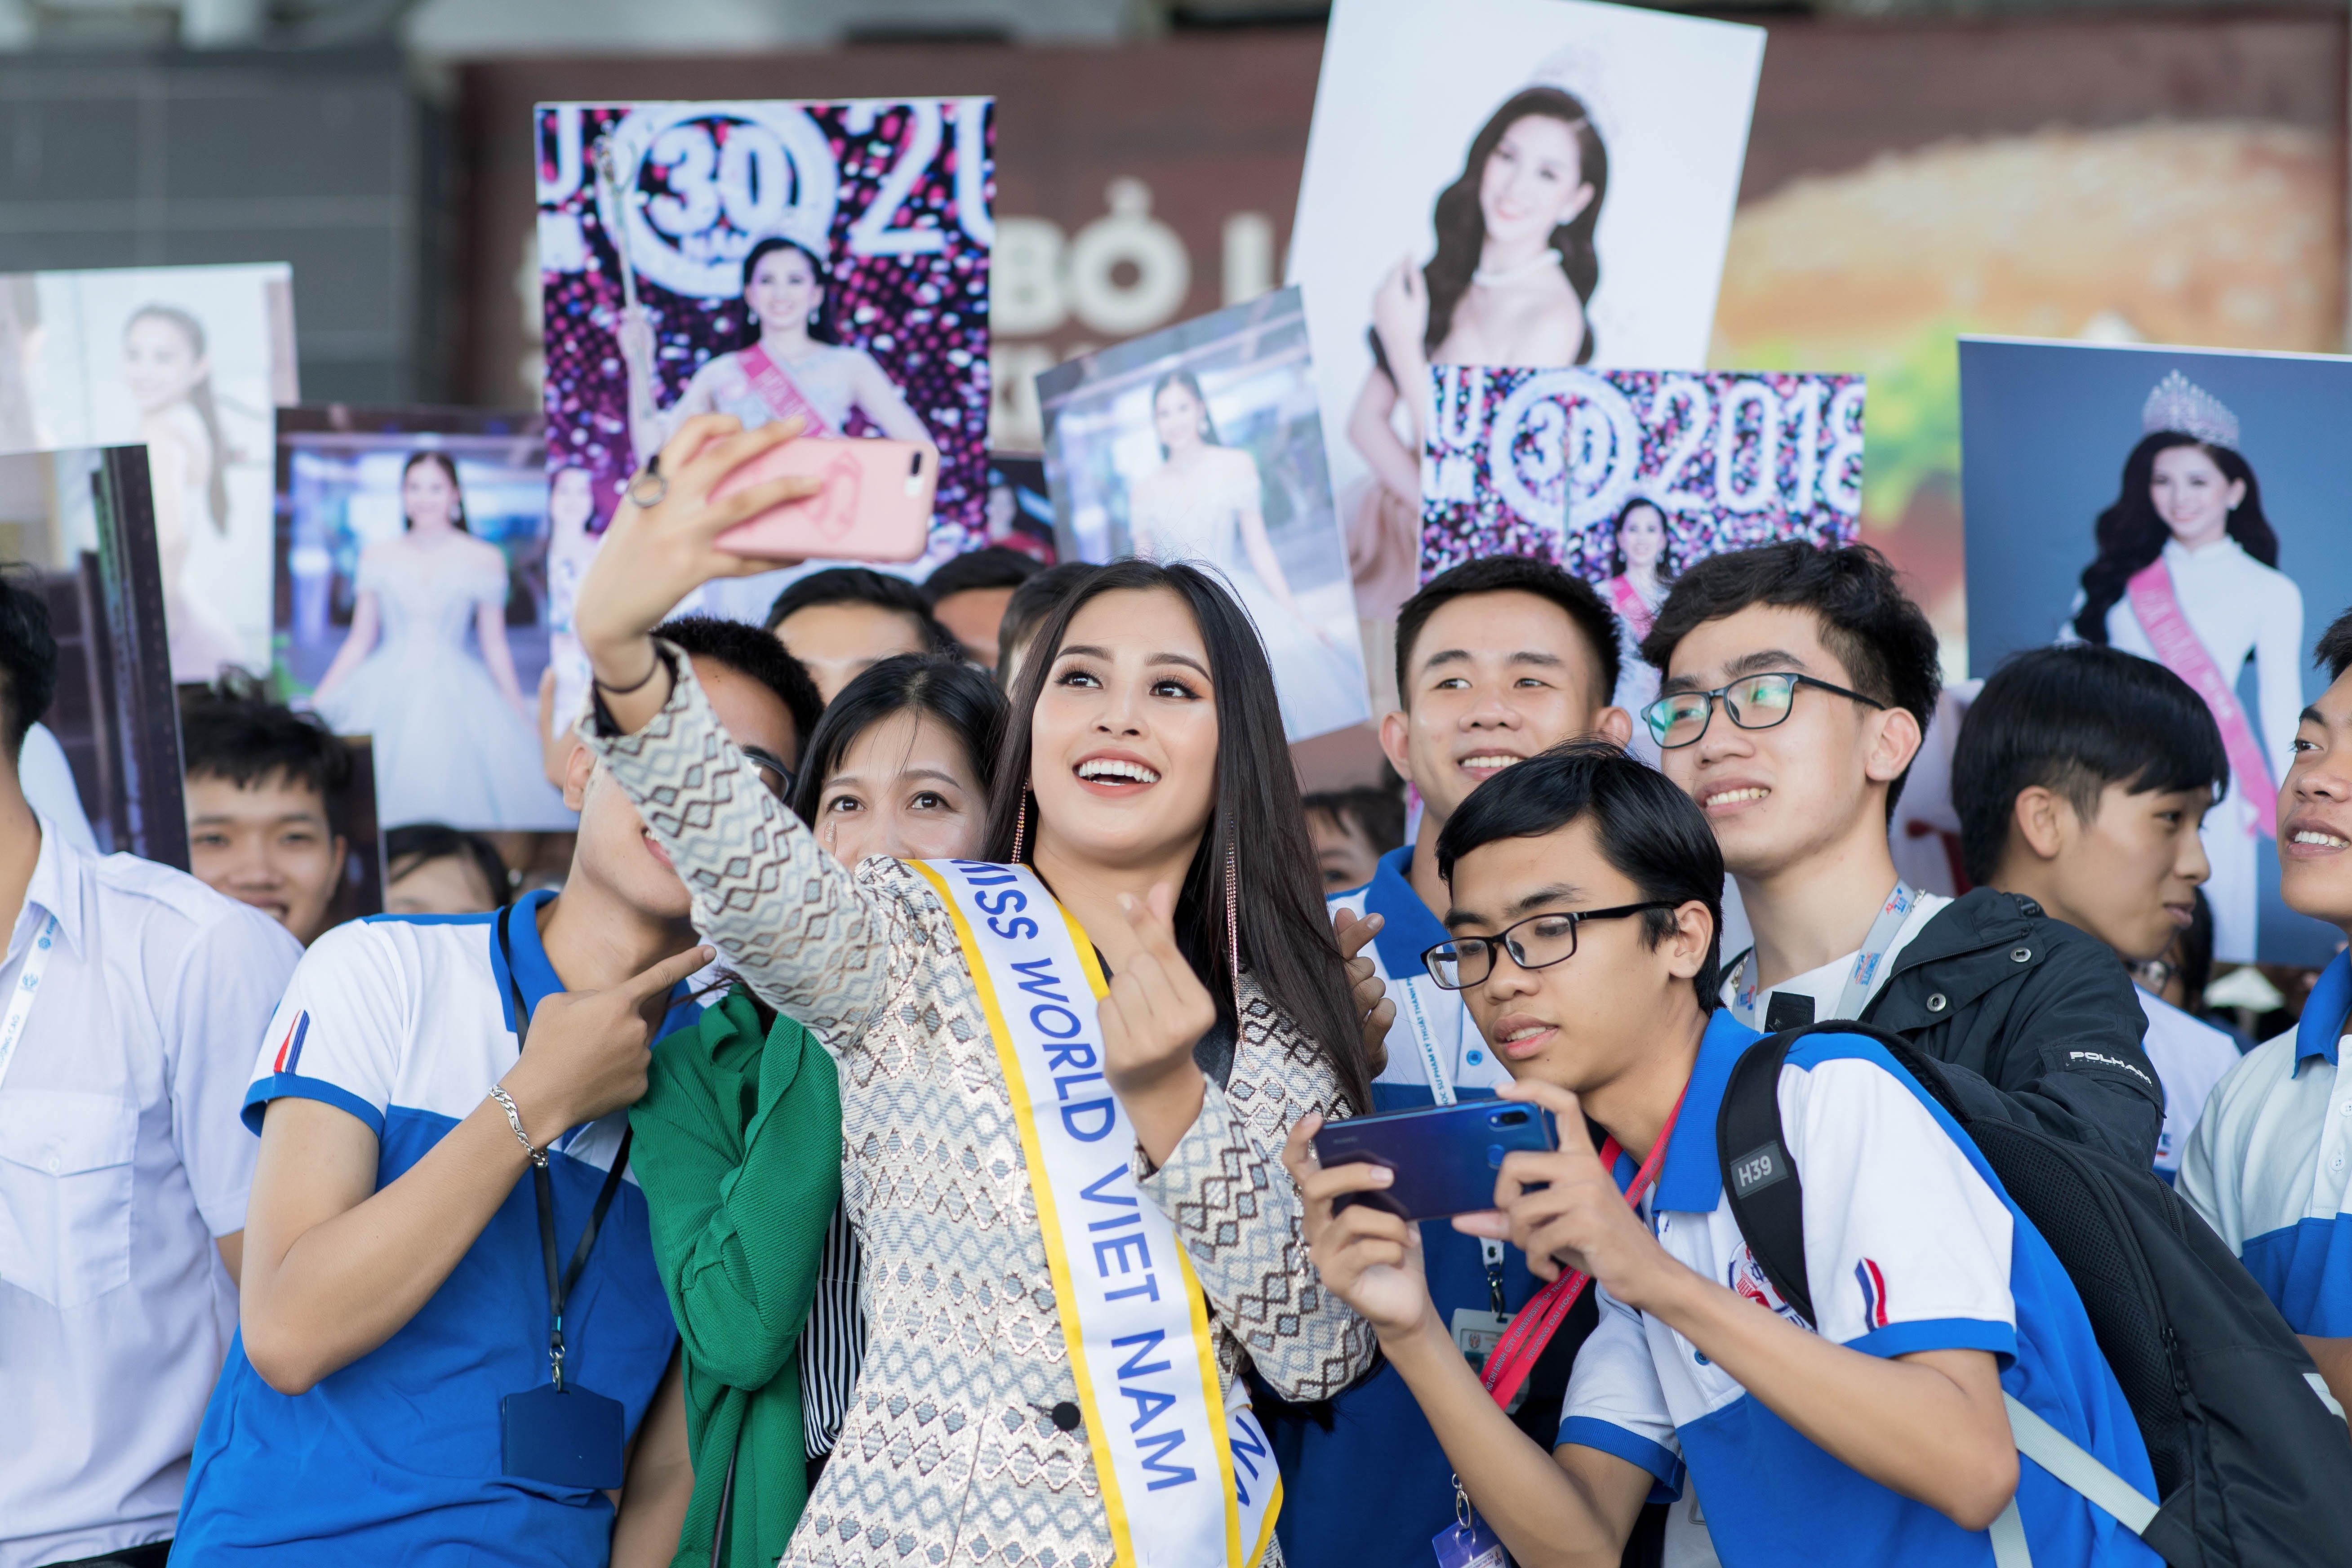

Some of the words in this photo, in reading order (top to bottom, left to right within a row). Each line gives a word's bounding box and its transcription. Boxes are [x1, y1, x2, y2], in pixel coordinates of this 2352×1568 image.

[649, 124, 791, 236] 30
[1521, 400, 1611, 485] 30
[1010, 958, 1115, 1142] WORLD
[2070, 1052, 2152, 1084] POLHAM
[1738, 1155, 1772, 1186] H39
[1080, 1163, 1159, 1301] VIET
[1487, 1371, 1498, 1382] CHI
[1493, 1352, 1507, 1371] MINH
[1503, 1337, 1516, 1352] CITY
[1513, 1300, 1544, 1337] UNIVERSITY
[1542, 1291, 1552, 1301] OF
[1111, 1328, 1197, 1492] NAM
